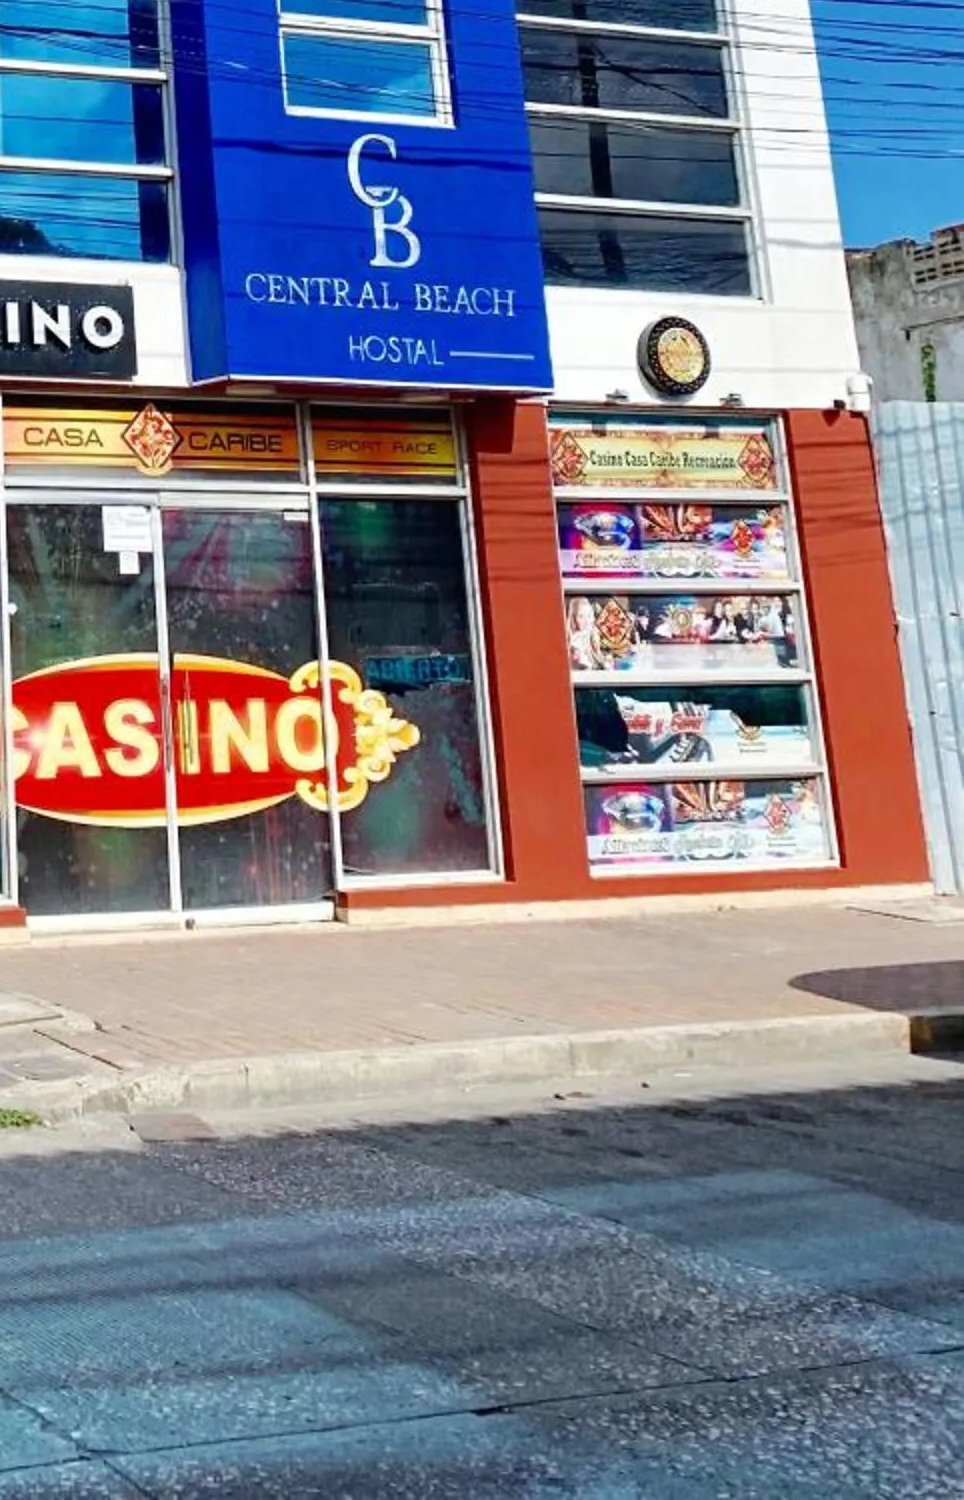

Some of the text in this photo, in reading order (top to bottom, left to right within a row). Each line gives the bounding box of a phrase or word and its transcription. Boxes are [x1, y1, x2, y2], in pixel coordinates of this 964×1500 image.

[244, 272, 517, 318] CENTRAL BEACH
[348, 334, 445, 366] HOSTAL
[23, 426, 283, 453] CASA CARIBE
[325, 437, 439, 456] SPORT RACE
[589, 450, 623, 467] Casino
[624, 451, 648, 467] Casa
[649, 452, 681, 469] Caribe
